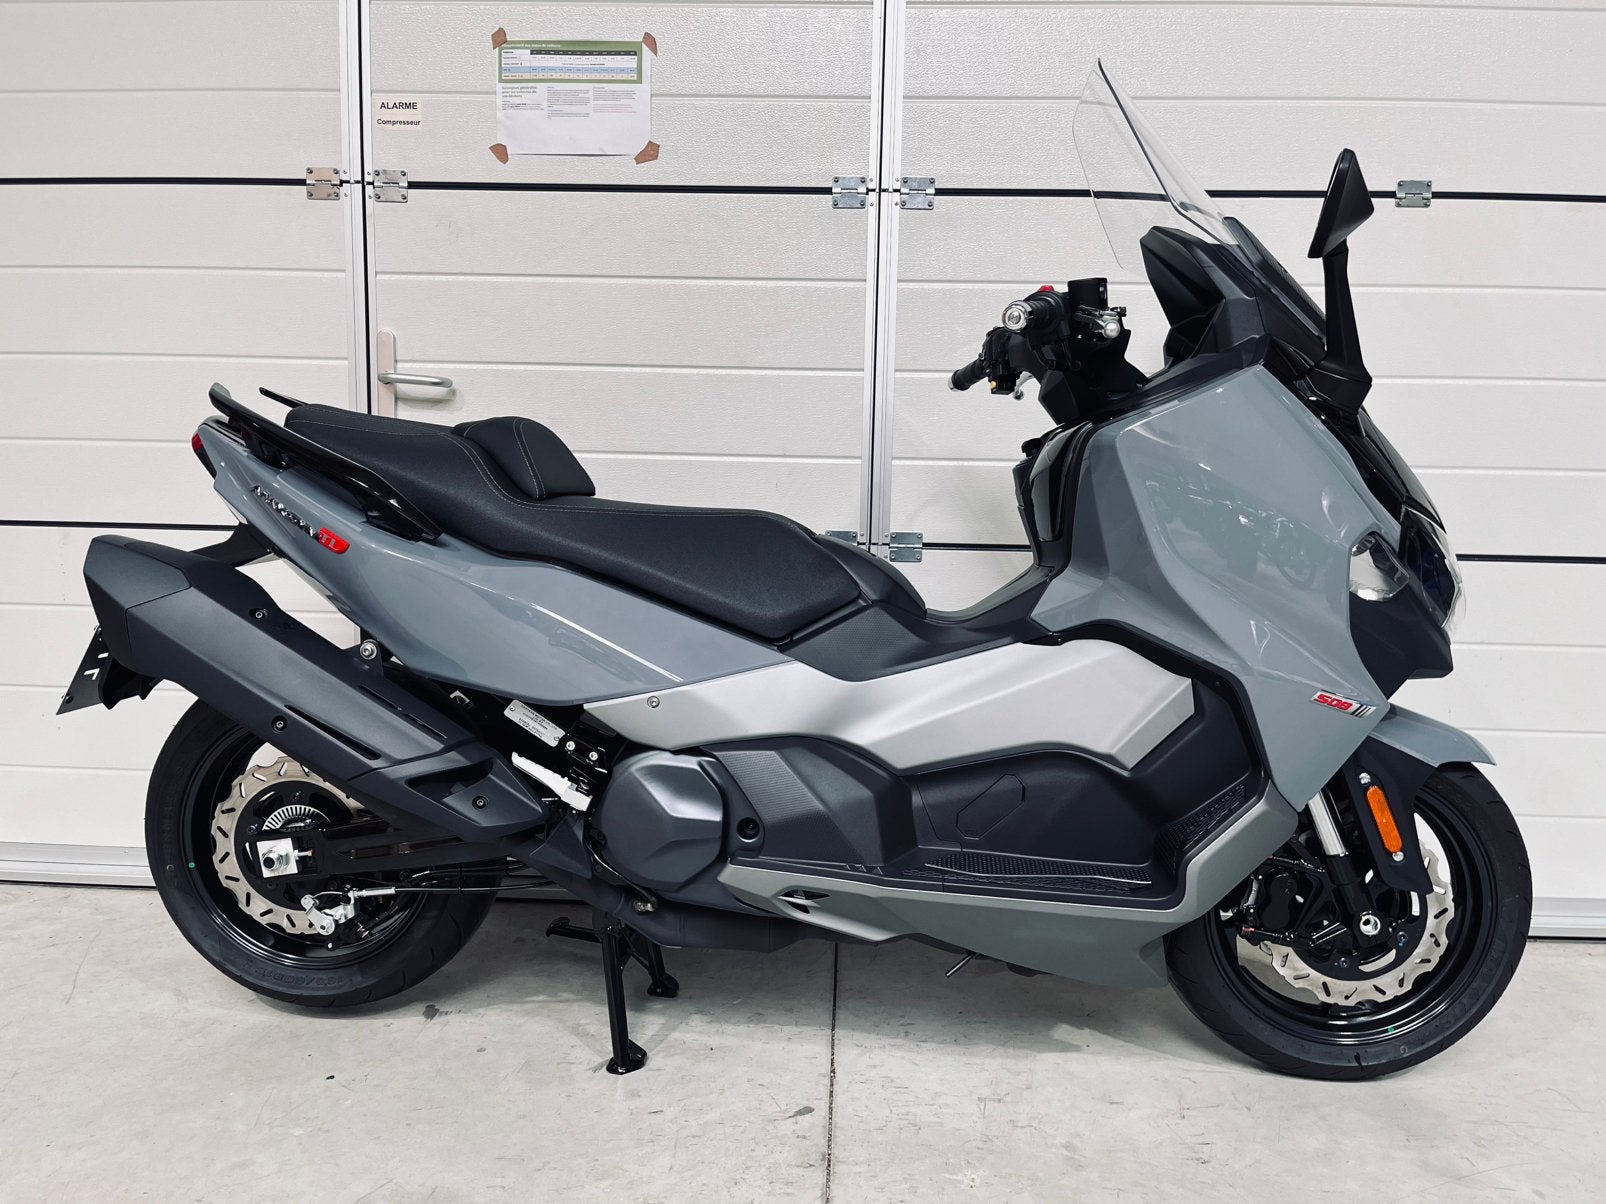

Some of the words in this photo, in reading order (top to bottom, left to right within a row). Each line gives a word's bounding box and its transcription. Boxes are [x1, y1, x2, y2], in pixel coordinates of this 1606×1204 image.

[380, 102, 418, 110] ALARME
[376, 118, 421, 126] Compresseur
[1313, 693, 1353, 711] 508
